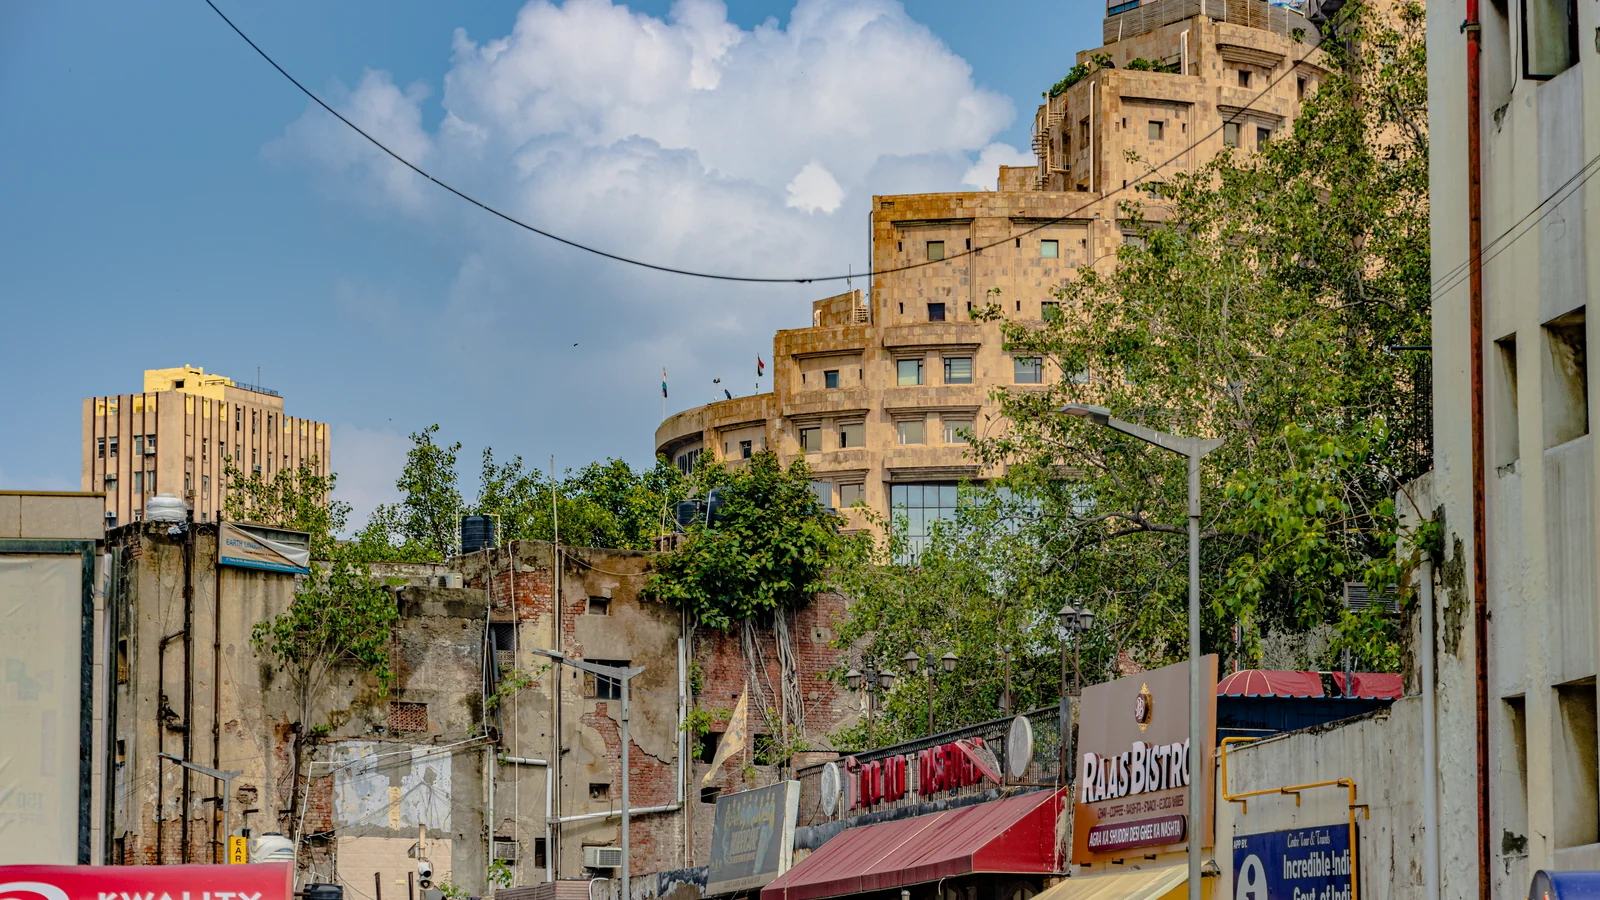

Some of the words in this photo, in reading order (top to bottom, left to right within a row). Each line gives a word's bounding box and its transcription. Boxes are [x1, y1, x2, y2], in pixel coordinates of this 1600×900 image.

[226, 539, 242, 547] EARTH
[1081, 752, 1131, 803] RAAS
[1089, 832, 1102, 847] AGRA
[1102, 829, 1109, 845] KA
[1109, 827, 1130, 844] SHUDDH
[1130, 825, 1140, 842] DESI
[1140, 823, 1153, 841] GHEE
[1153, 822, 1160, 839] KA
[1160, 819, 1181, 837] NASHTA
[1283, 851, 1331, 880] Incredible
[1331, 883, 1353, 900] Indi
